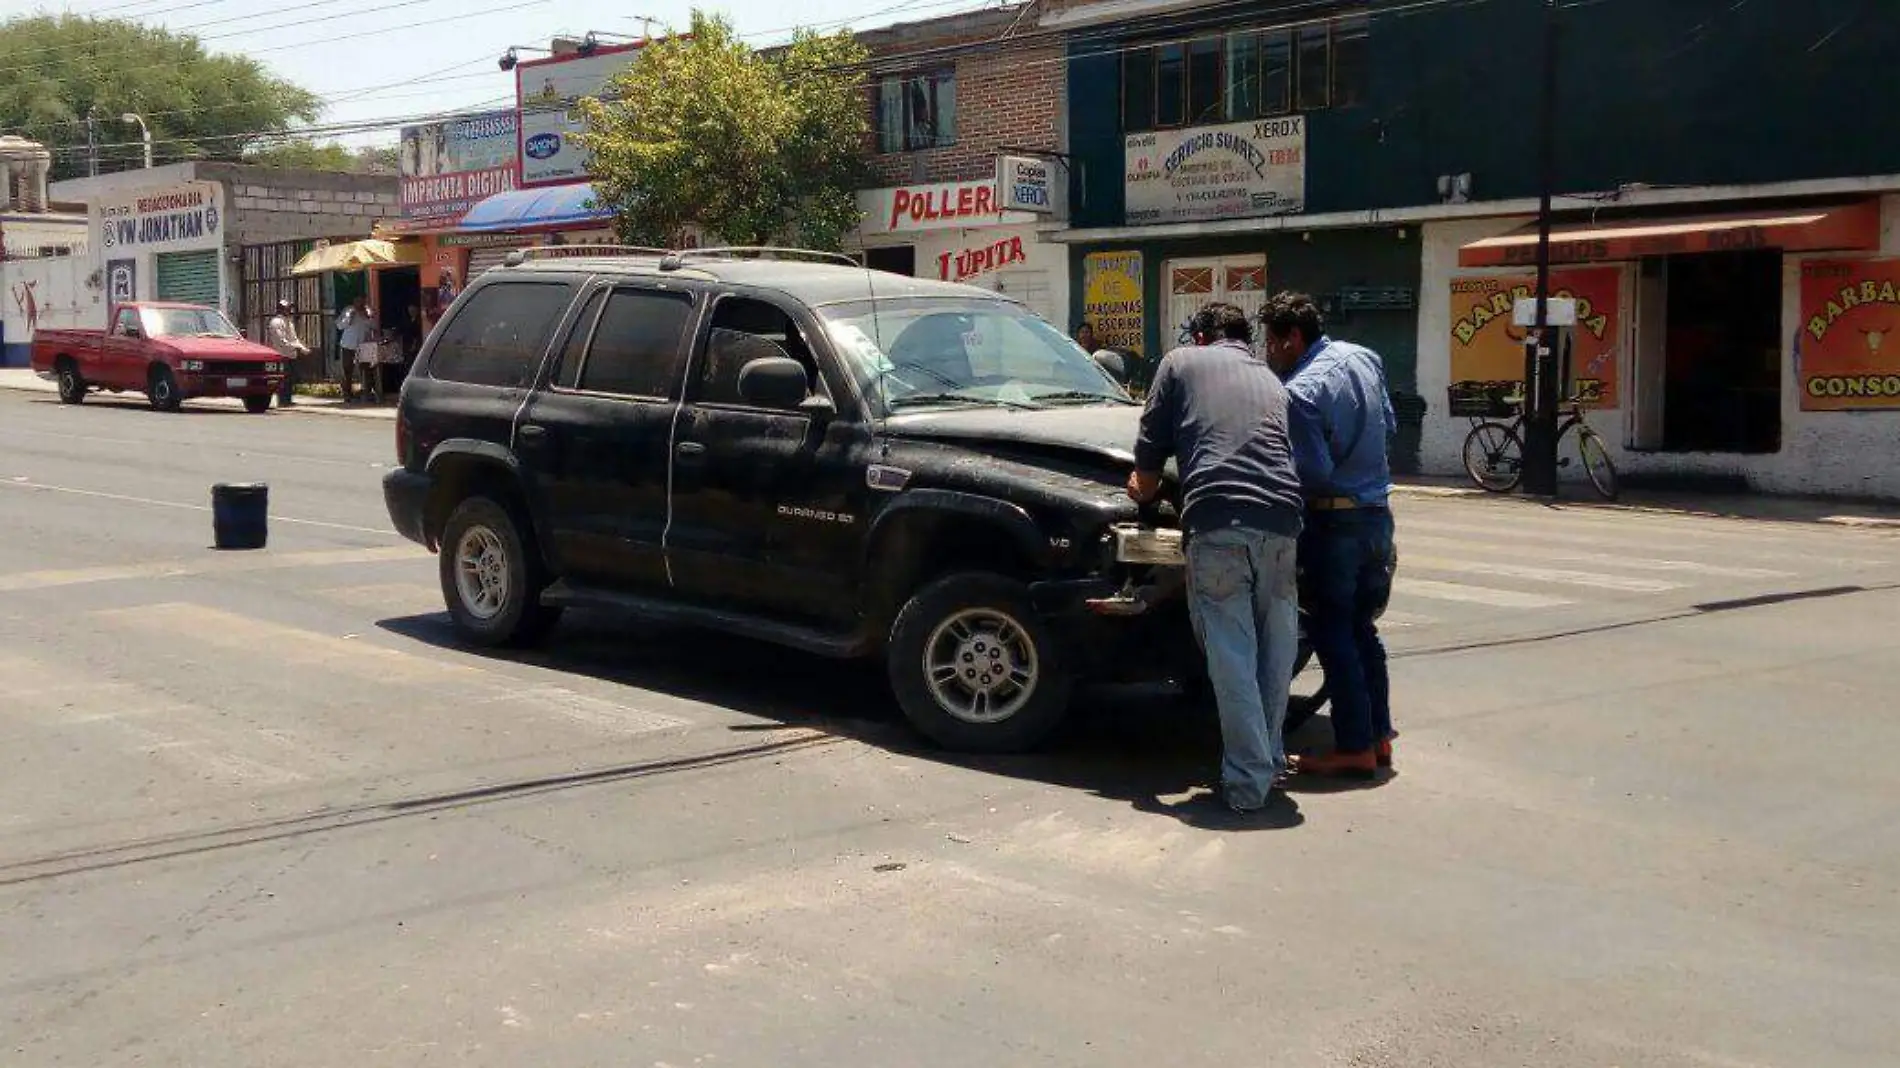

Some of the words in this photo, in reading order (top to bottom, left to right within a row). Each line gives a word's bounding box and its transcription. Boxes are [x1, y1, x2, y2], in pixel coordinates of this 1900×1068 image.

[1253, 118, 1301, 139] XEROX
[1164, 132, 1213, 172] SERVICIO
[404, 175, 463, 204] IMPRENTA
[468, 168, 514, 197] DIGITAL
[117, 218, 136, 245] VW
[139, 211, 202, 244] JONATHAN
[1451, 284, 1607, 346] BARBOA
[1807, 279, 1900, 342] BARBA
